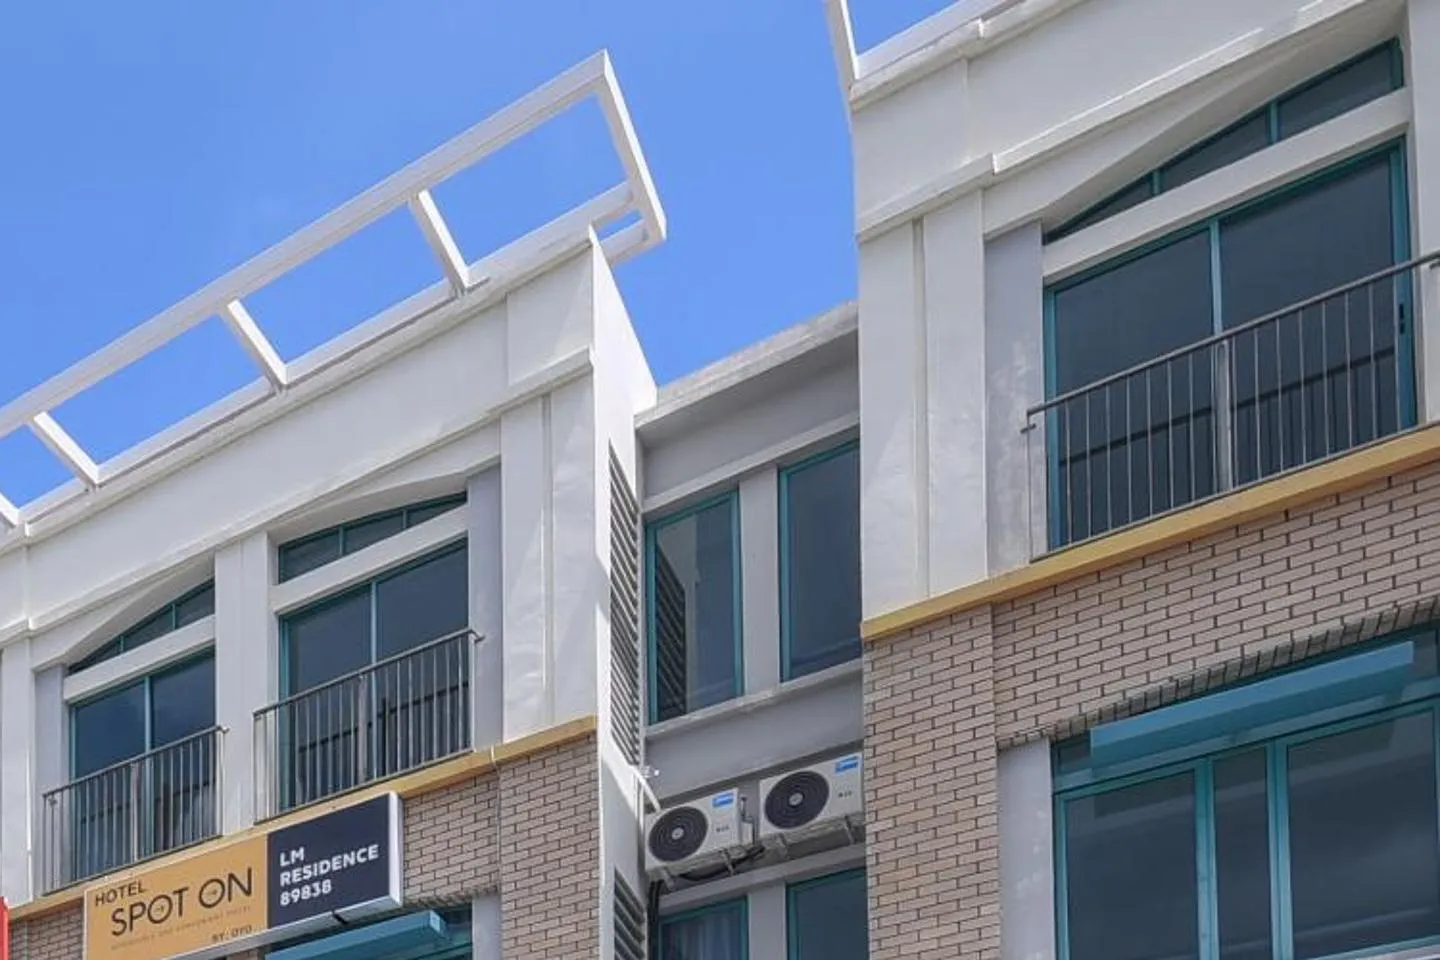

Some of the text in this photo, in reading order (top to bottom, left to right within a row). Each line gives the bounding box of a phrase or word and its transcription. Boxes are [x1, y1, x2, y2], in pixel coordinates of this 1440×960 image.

[279, 844, 379, 886] RESIDENCE
[280, 846, 305, 867] LM
[94, 880, 146, 906] HOTEL
[111, 887, 188, 936] SPOT
[198, 867, 253, 908] ON
[279, 879, 332, 906] 89838
